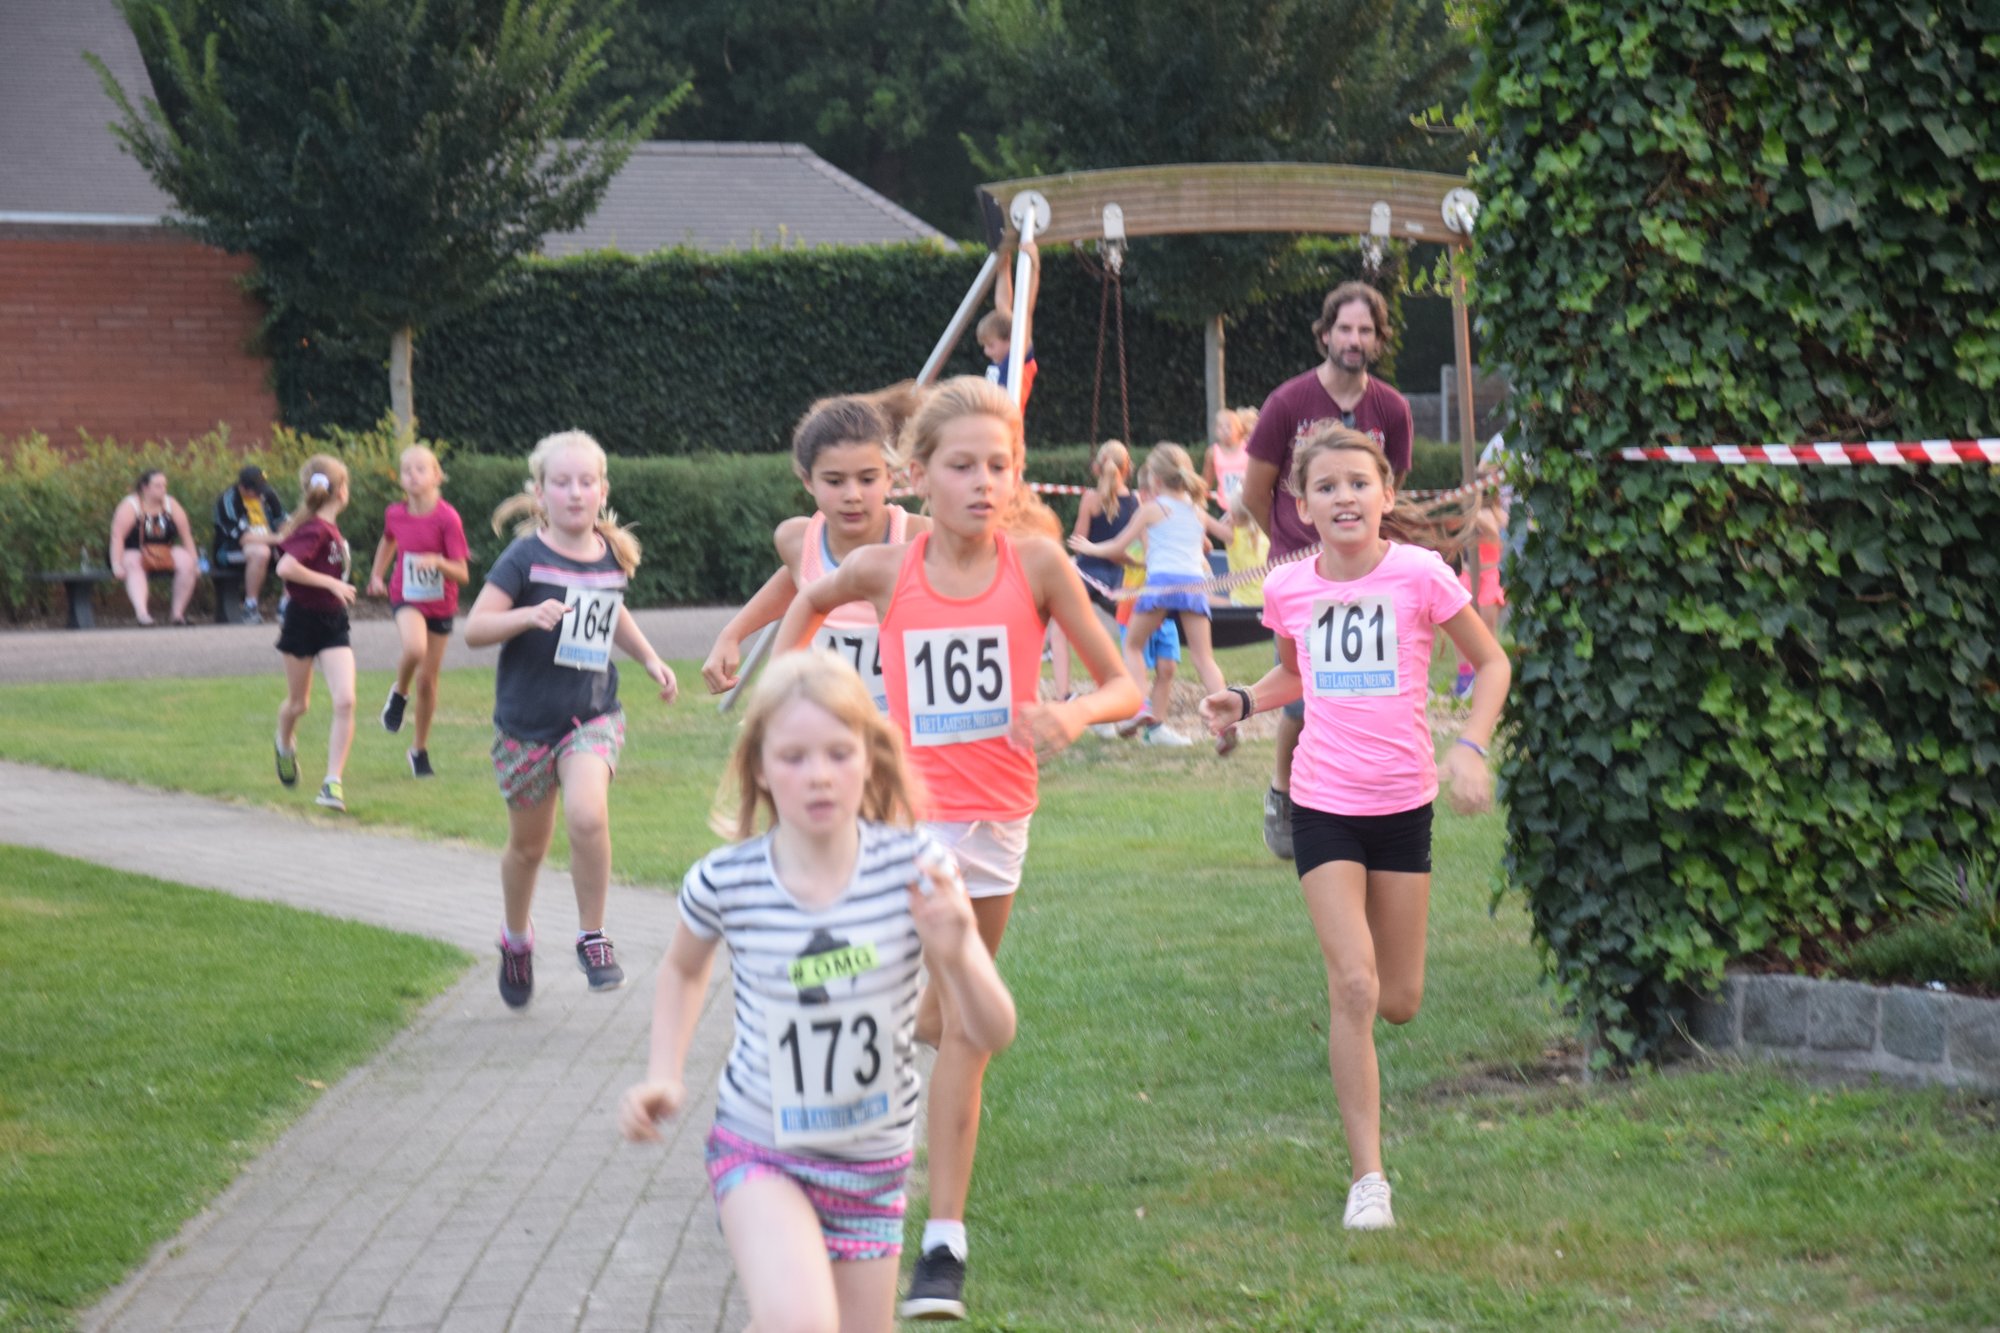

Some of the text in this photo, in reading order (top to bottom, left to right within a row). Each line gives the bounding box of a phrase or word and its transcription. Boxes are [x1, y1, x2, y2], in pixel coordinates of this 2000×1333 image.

[571, 595, 615, 641] 164
[1317, 604, 1384, 663] 161
[914, 637, 1003, 706] 165
[779, 1012, 882, 1095] 173
